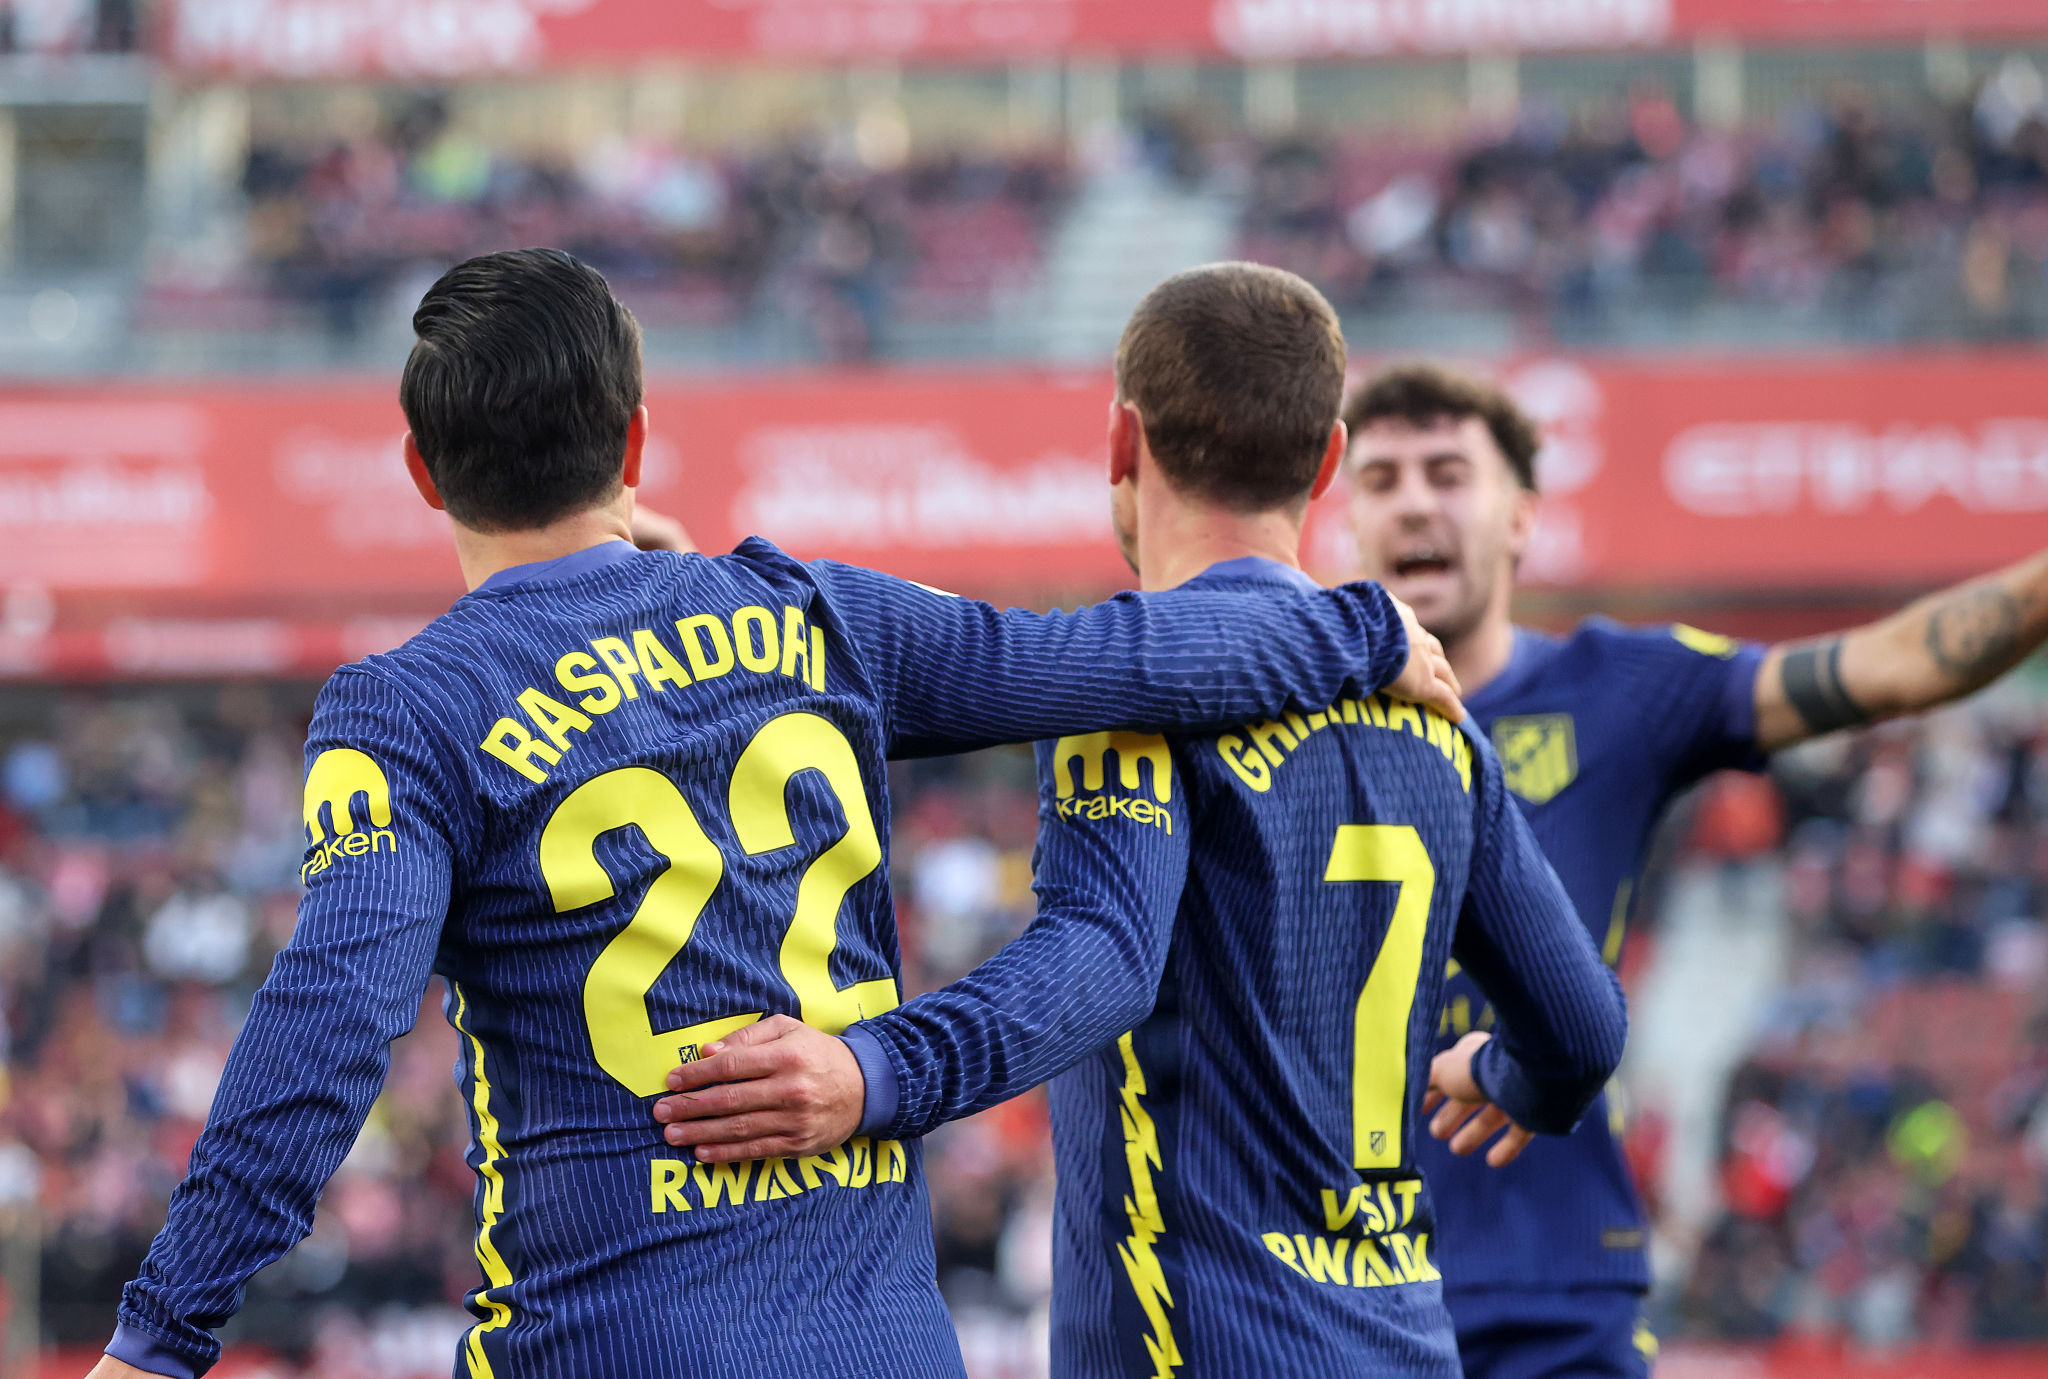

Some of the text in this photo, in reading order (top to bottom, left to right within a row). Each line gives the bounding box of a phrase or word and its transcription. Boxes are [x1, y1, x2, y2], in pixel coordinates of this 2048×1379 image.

[480, 605, 826, 784] RASPADORI
[301, 829, 397, 885] raken
[1056, 795, 1172, 836] kraken
[539, 712, 900, 1099] 22
[1323, 823, 1436, 1170] 7
